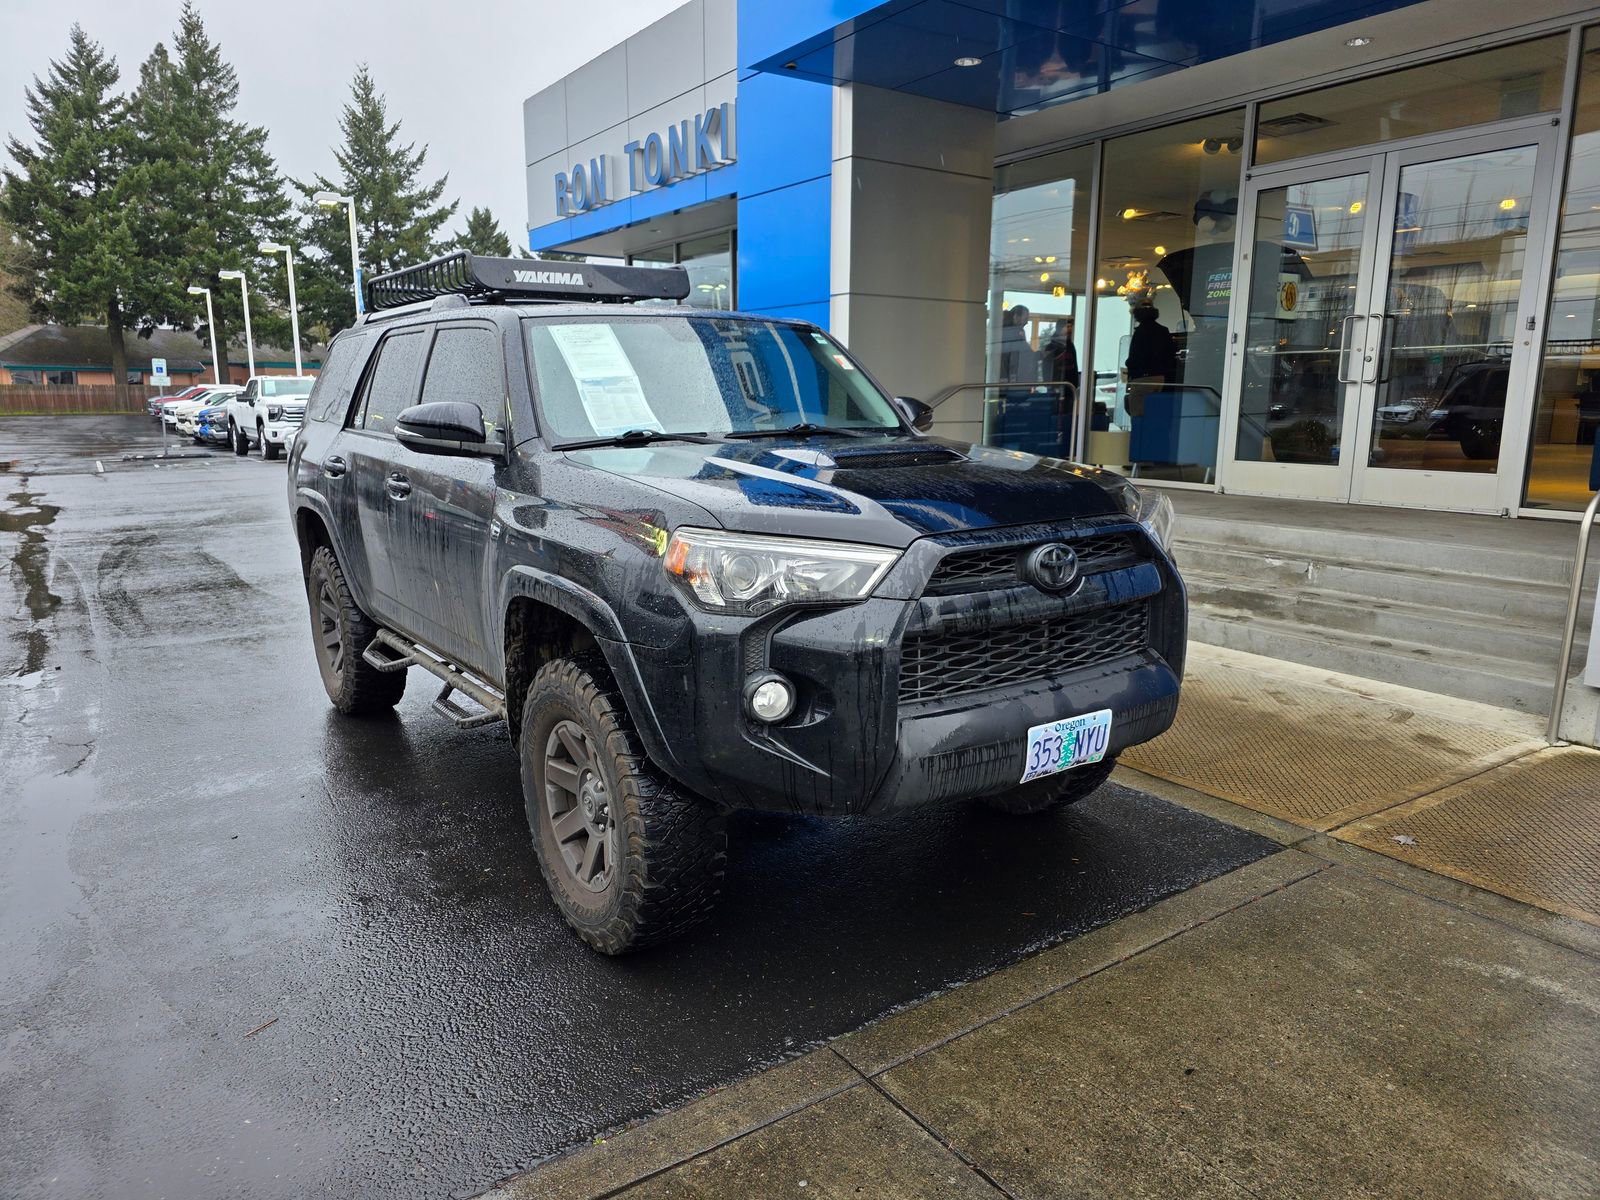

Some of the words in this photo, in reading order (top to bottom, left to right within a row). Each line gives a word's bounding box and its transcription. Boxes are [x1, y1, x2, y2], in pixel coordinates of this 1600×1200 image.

[555, 154, 610, 217] RON
[624, 98, 738, 192] TONKI
[513, 270, 584, 286] YAKIMA
[1054, 718, 1086, 733] Oregon
[1030, 735, 1063, 771] 353
[1072, 723, 1107, 759] NYU
